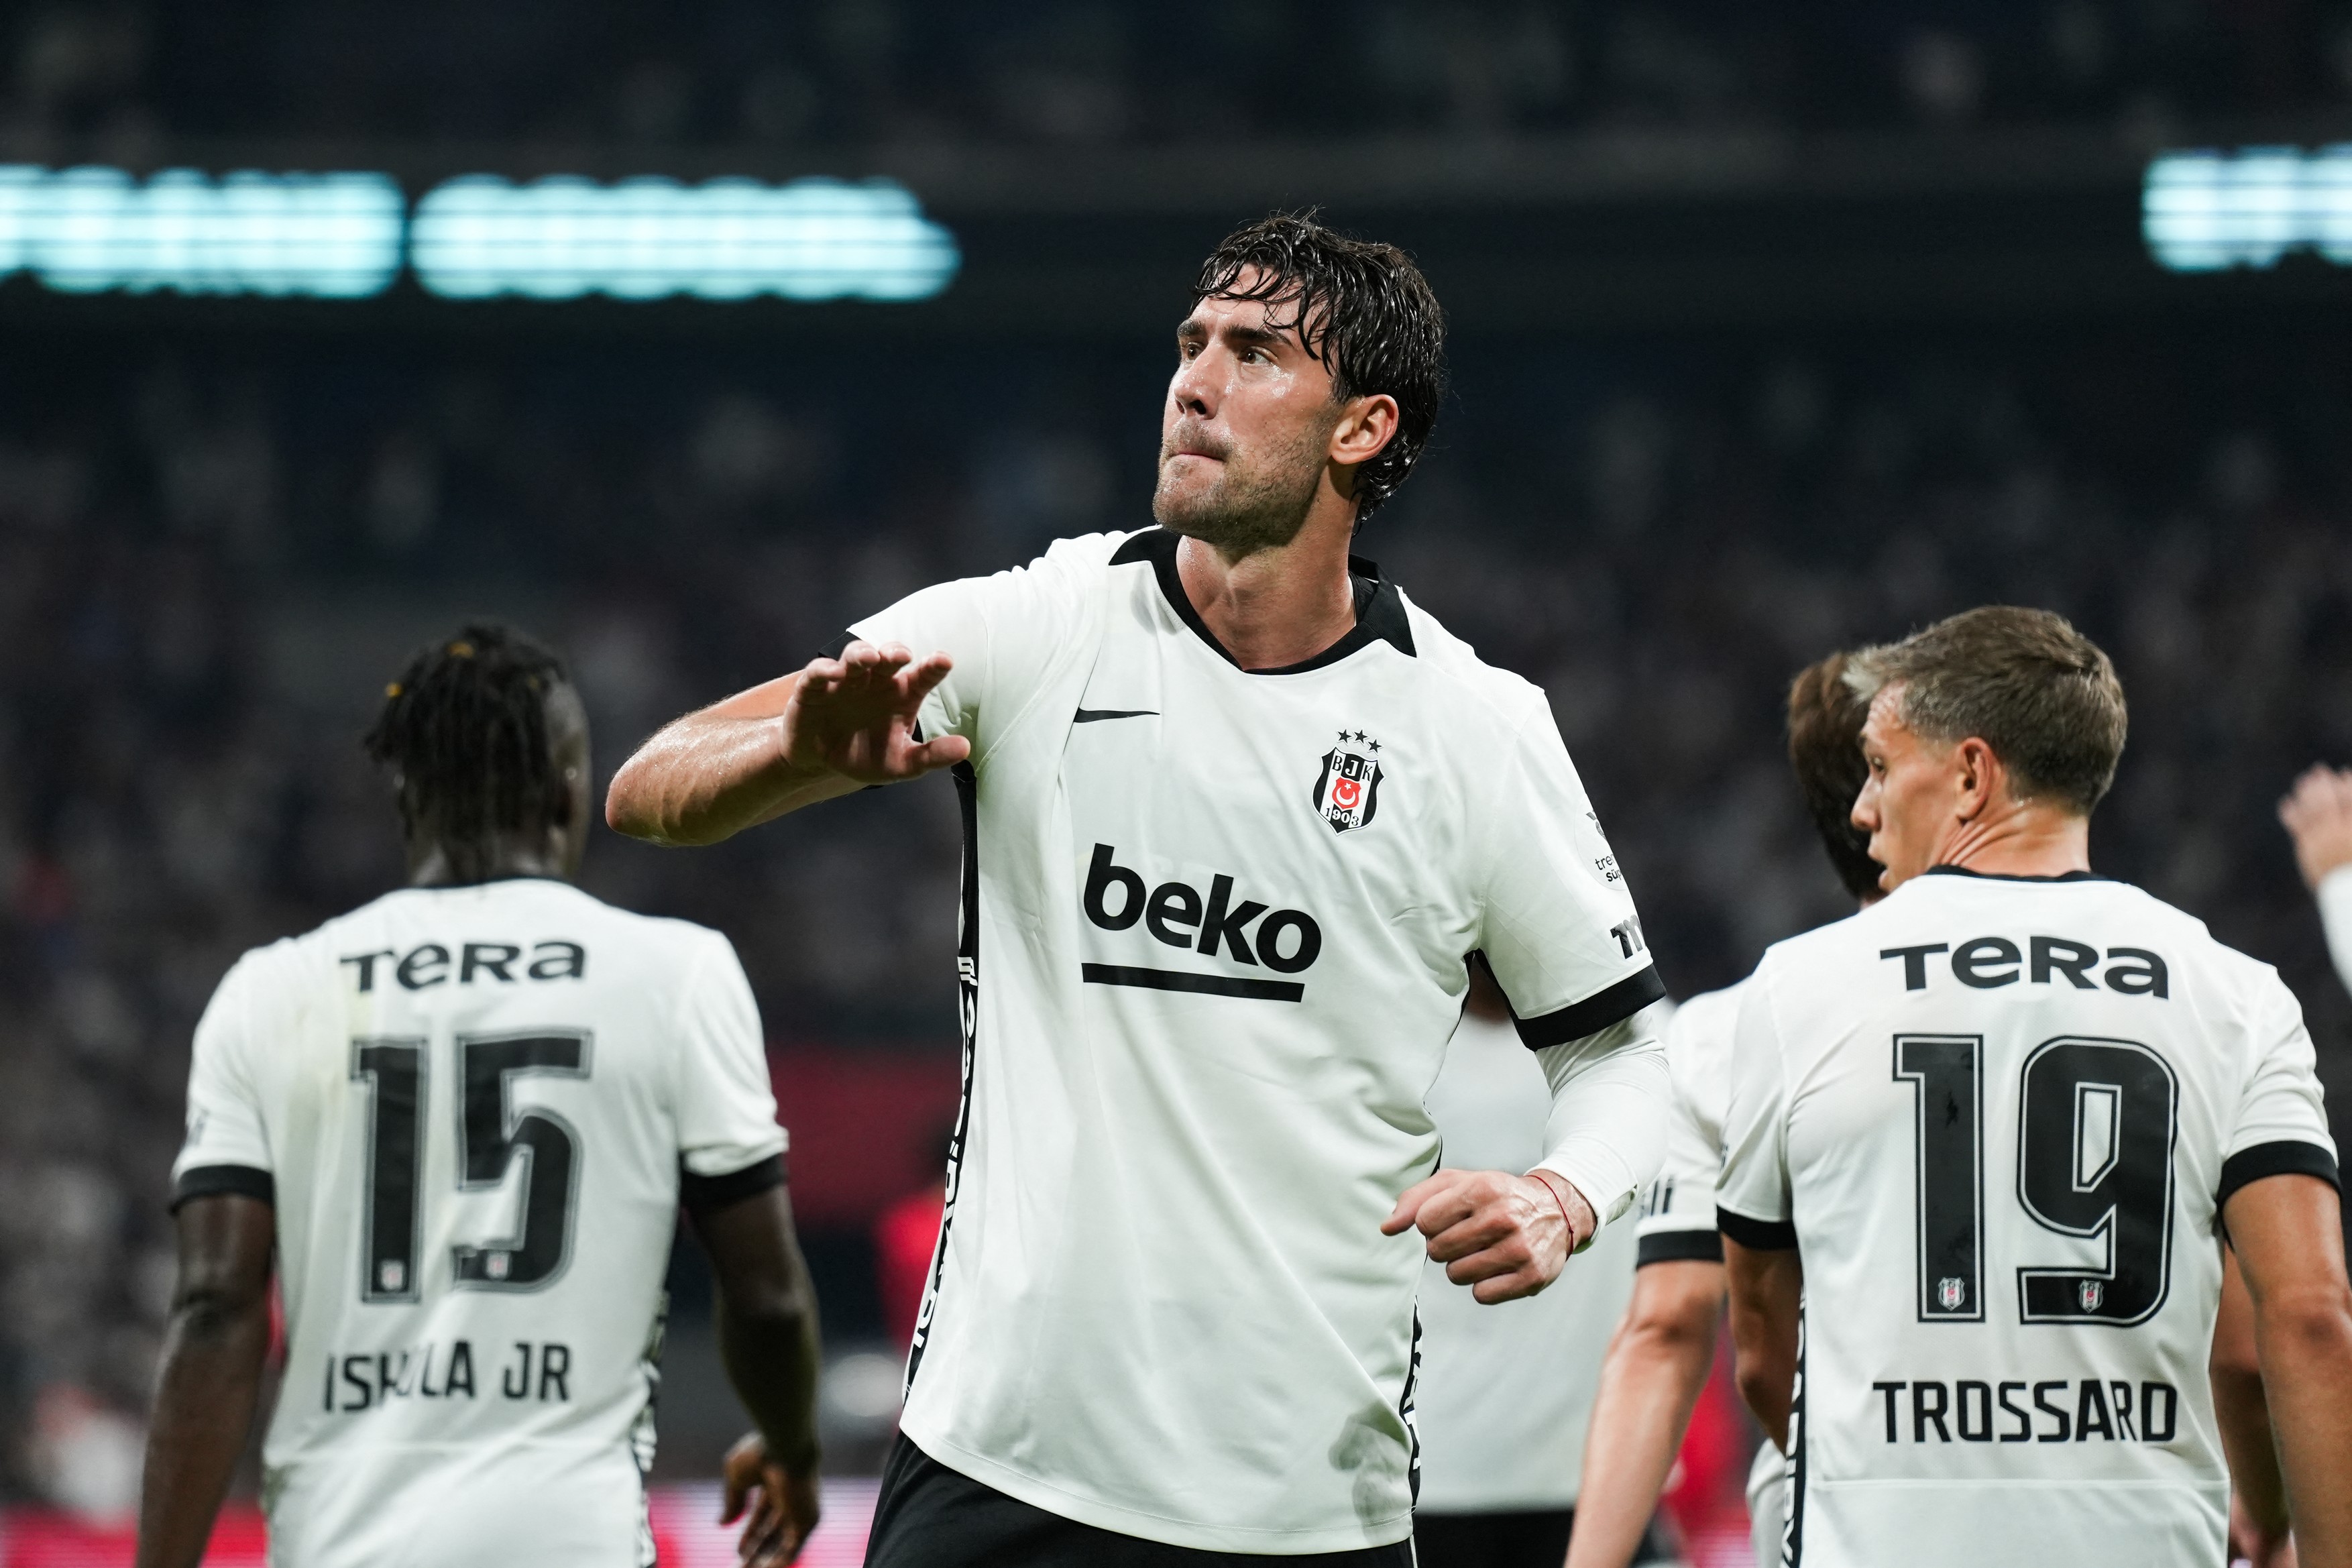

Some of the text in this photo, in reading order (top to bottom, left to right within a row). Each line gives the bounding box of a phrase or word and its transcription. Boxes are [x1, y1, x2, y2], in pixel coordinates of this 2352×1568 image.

[1332, 755, 1373, 781] BJK
[1325, 807, 1359, 826] 1903
[1082, 842, 1322, 974] beko
[349, 1029, 593, 1304] 15
[1892, 1033, 2179, 1329] 19
[323, 1339, 571, 1414] ISHLA JR
[1872, 1379, 2178, 1444] TROSSARD
